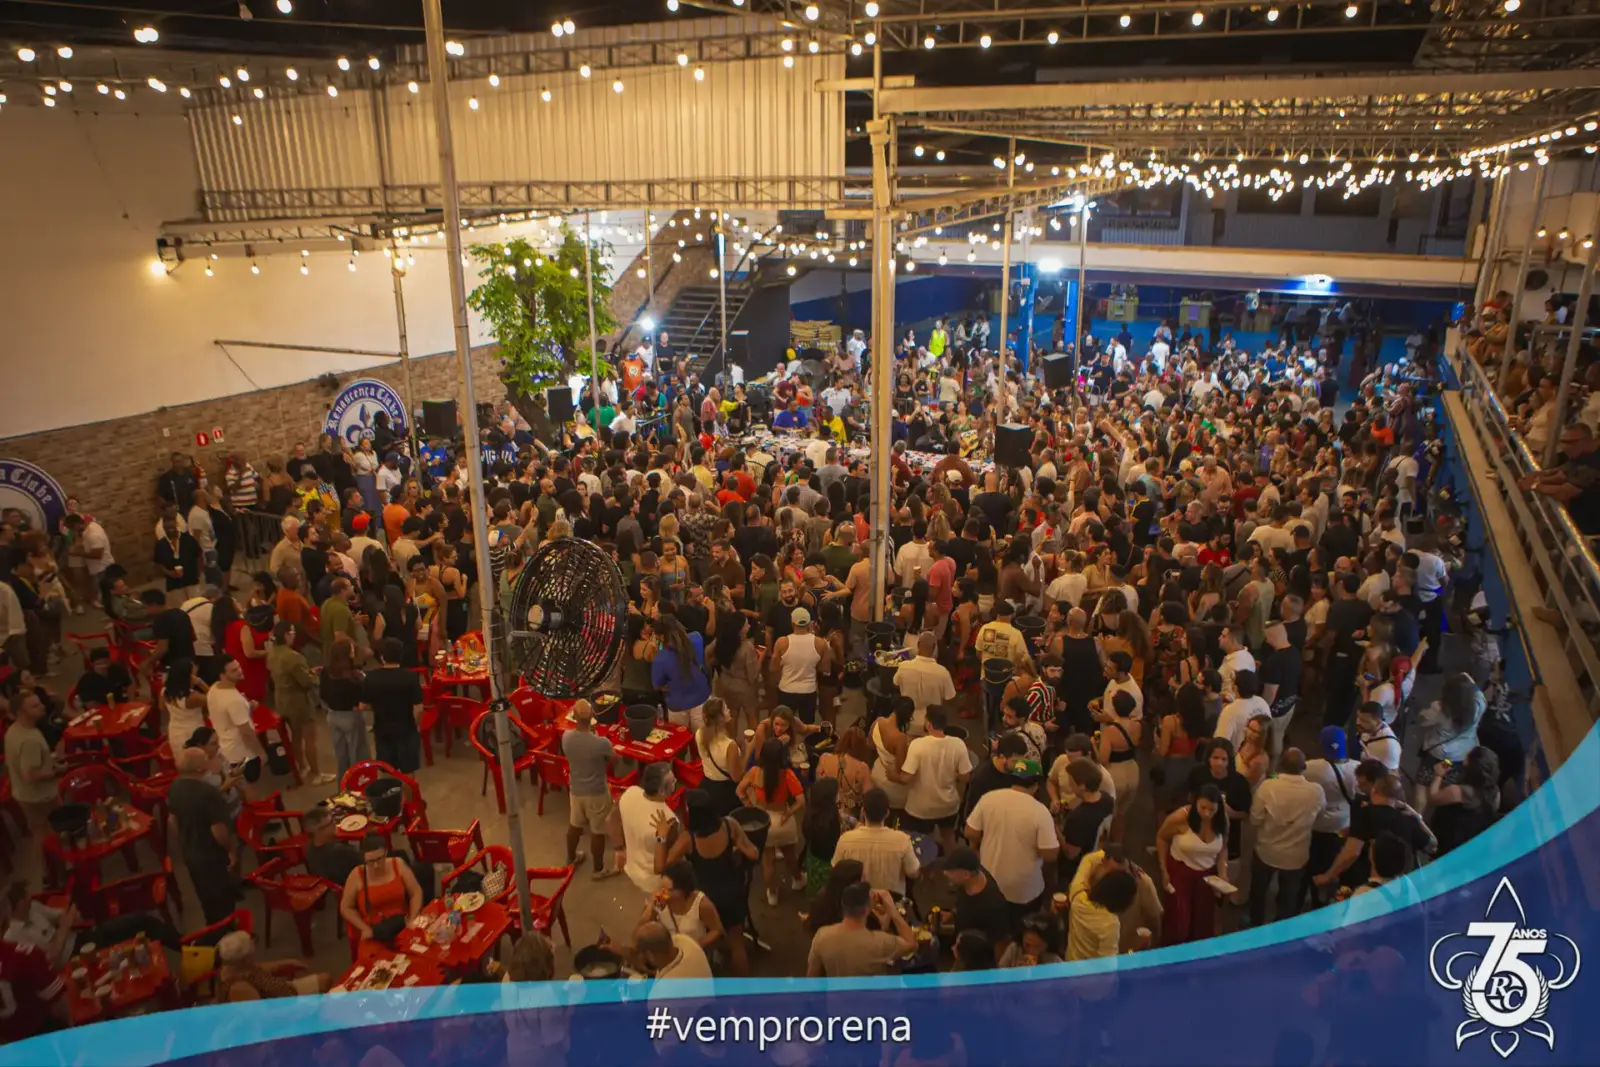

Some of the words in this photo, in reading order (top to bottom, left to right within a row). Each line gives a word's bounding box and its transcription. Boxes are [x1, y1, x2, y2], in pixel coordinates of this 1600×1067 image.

[328, 387, 375, 430] Renascença
[376, 388, 399, 416] Clube
[10, 468, 52, 504] Clube
